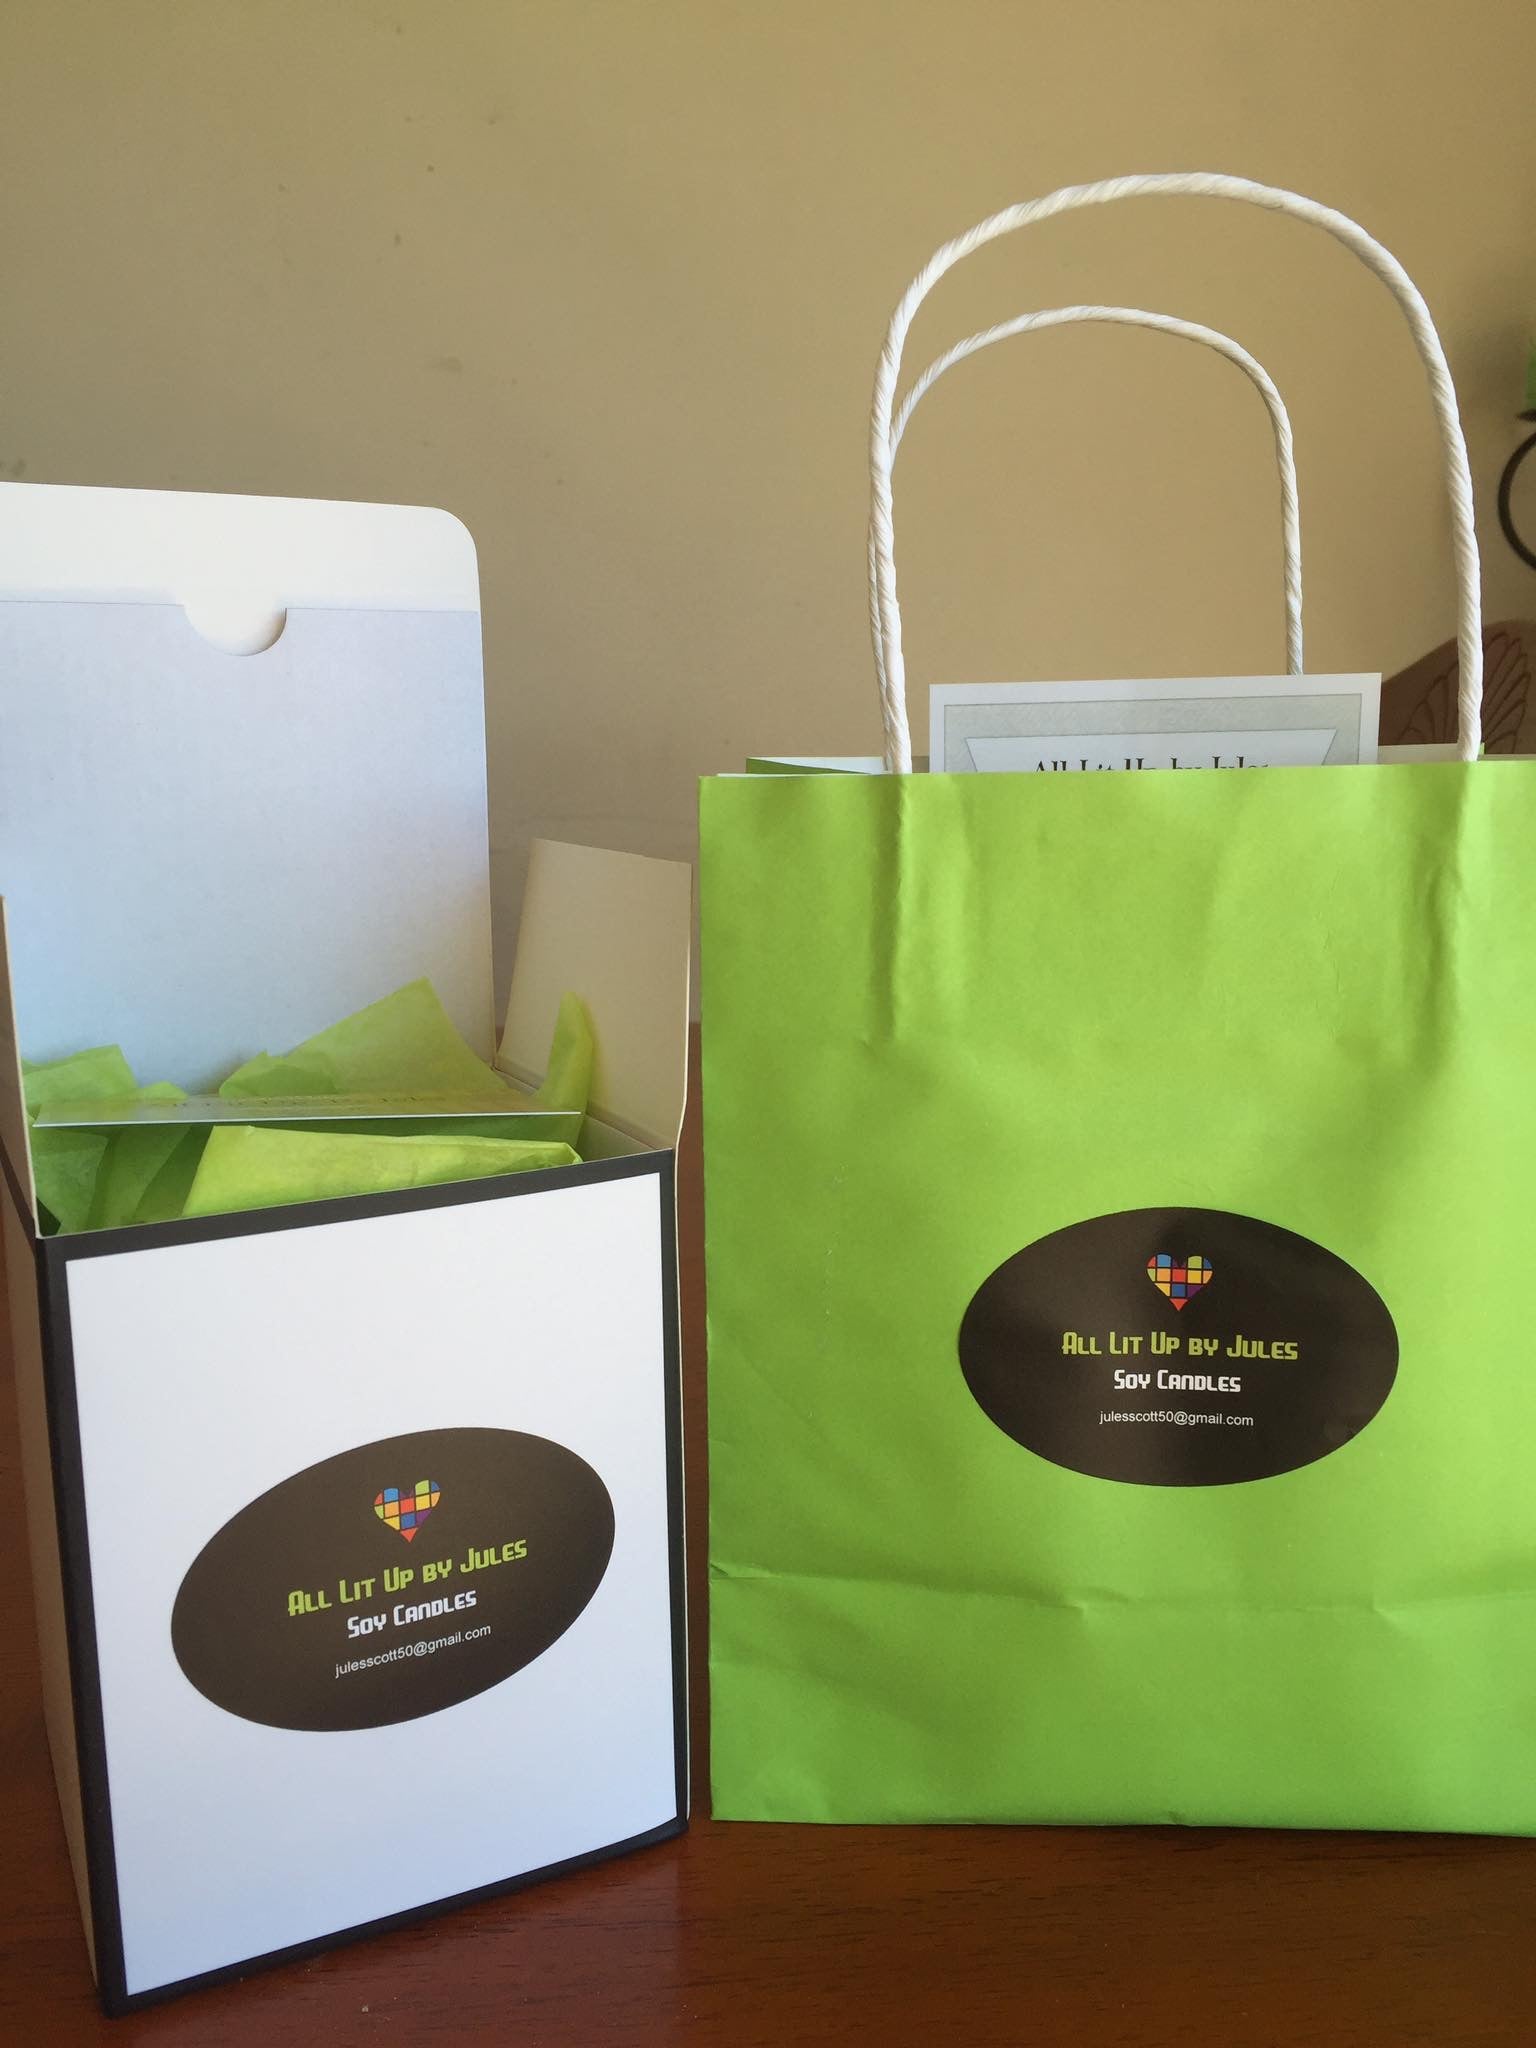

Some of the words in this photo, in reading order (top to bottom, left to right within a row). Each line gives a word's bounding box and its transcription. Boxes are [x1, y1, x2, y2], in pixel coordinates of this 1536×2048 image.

[1226, 1334, 1298, 1361] JULES
[1156, 1369, 1242, 1393] CANDLES
[1099, 1410, 1254, 1426] julesscott50@gmail.com
[459, 1539, 528, 1573] JULES
[393, 1589, 477, 1627] CANDLES
[334, 1624, 492, 1679] julesscott50@gmail.com
